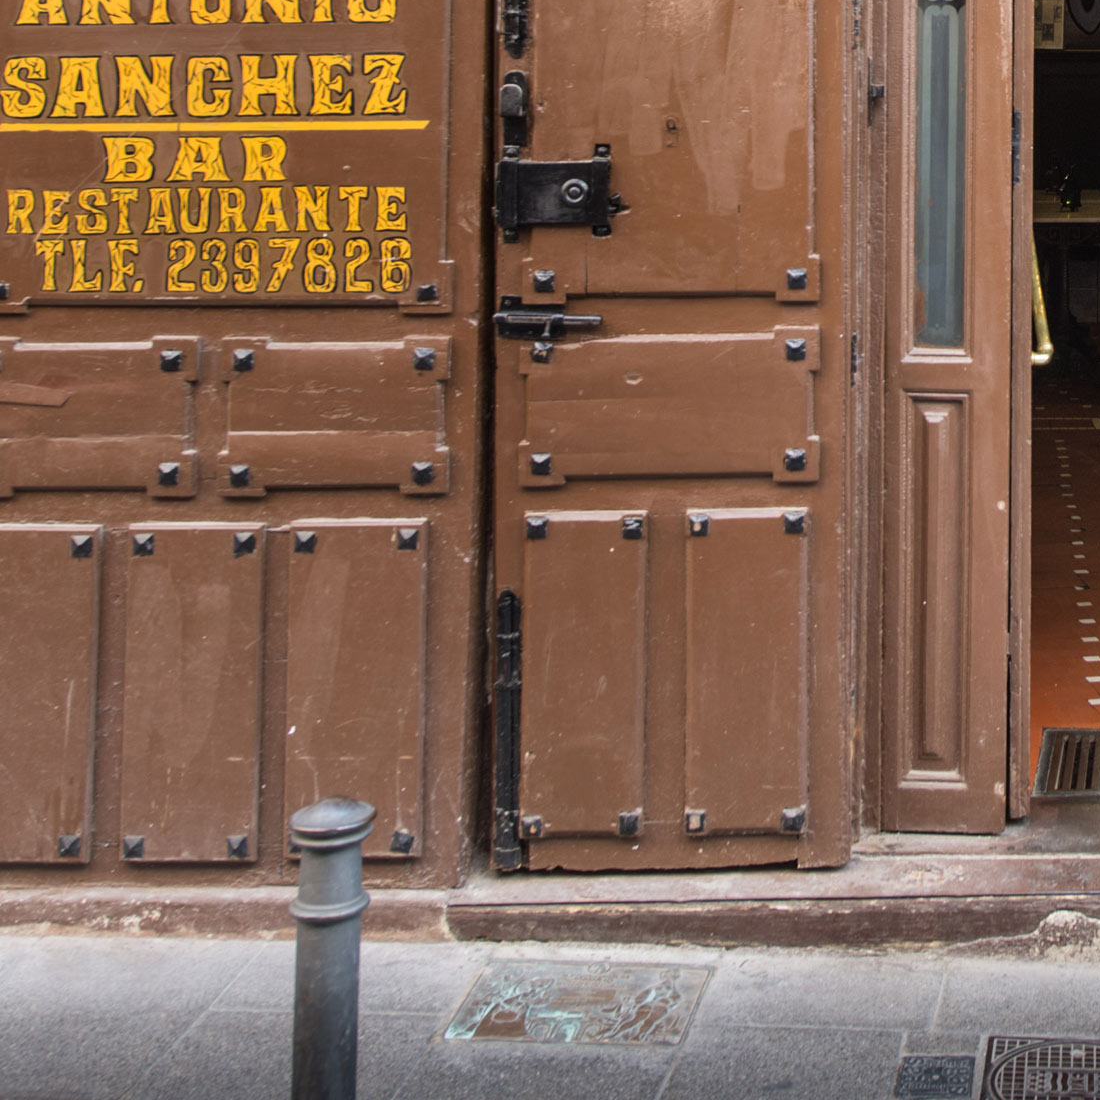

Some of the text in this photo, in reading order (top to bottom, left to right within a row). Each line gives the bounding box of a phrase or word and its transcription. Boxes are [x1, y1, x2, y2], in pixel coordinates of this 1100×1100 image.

[0, 54, 408, 119] SANCHEZ
[102, 135, 288, 183] BAR
[6, 186, 408, 235] RESTAURANTE
[165, 237, 412, 293] 2397826
